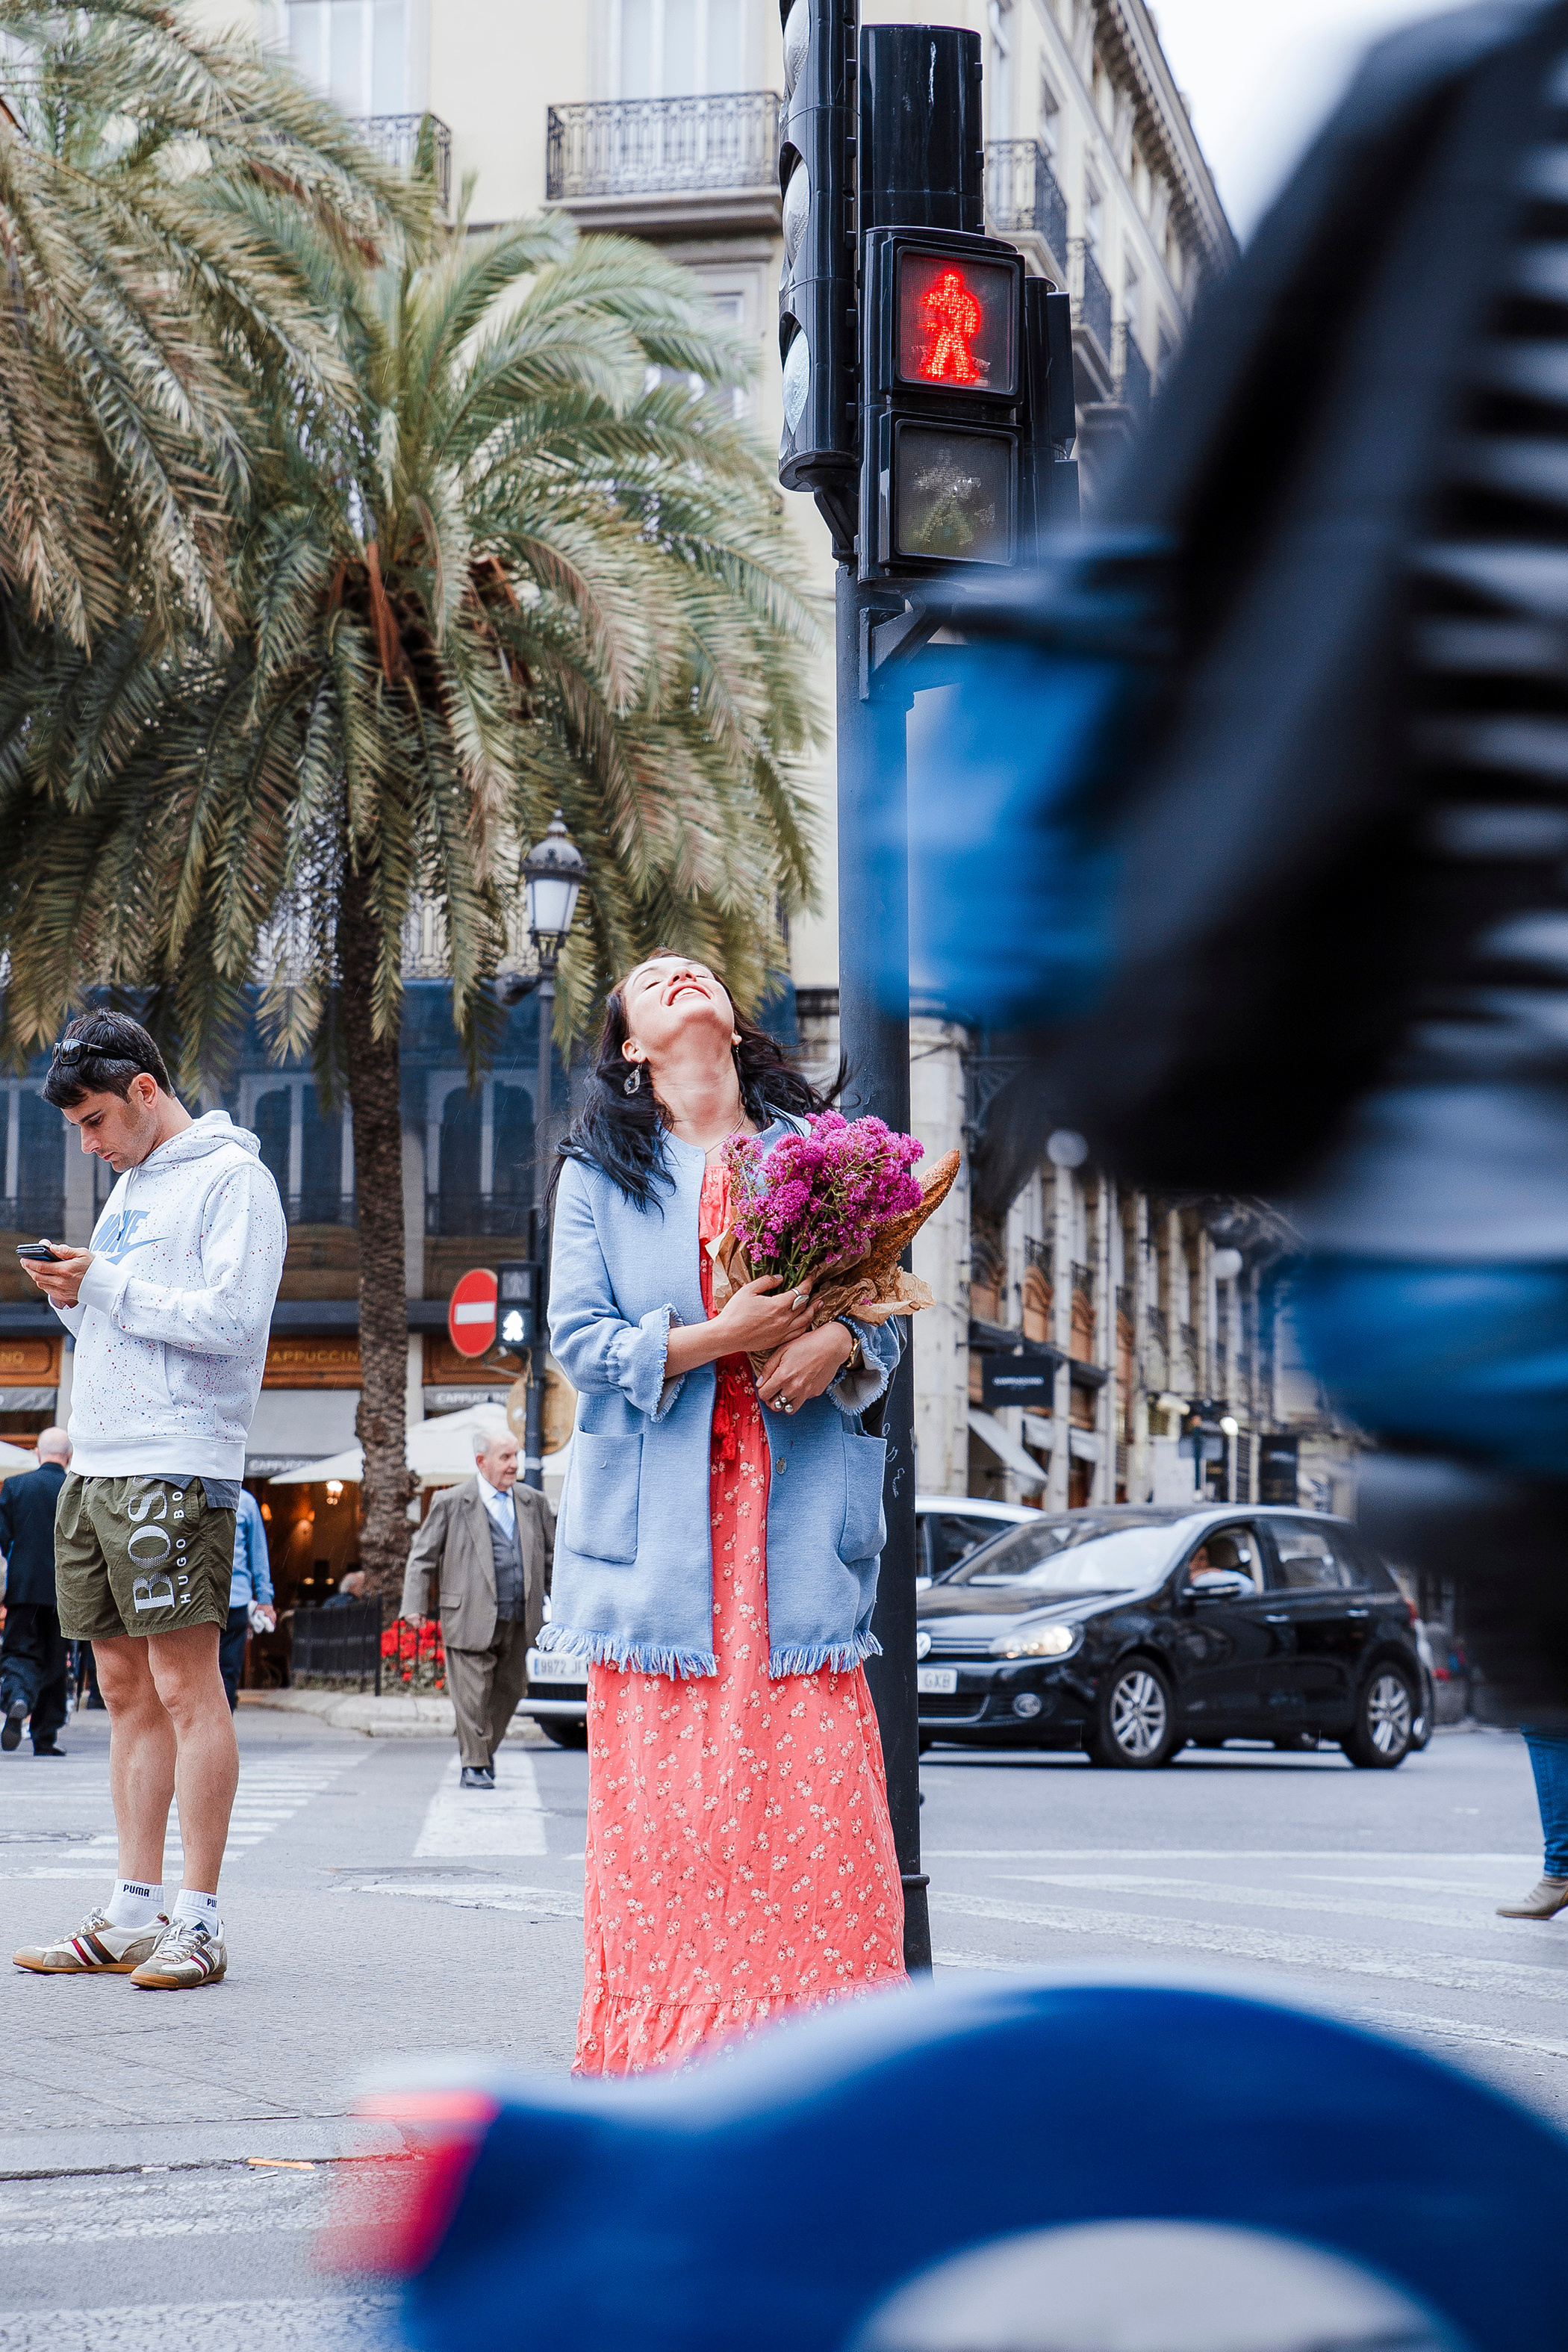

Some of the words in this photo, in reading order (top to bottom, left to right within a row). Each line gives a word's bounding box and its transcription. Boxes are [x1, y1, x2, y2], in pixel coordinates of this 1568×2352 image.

[90, 1210, 150, 1253] NIKE
[267, 1351, 358, 1363] APPUCCIN
[176, 1538, 191, 1605] HUGO
[123, 1884, 150, 1897] PUMA
